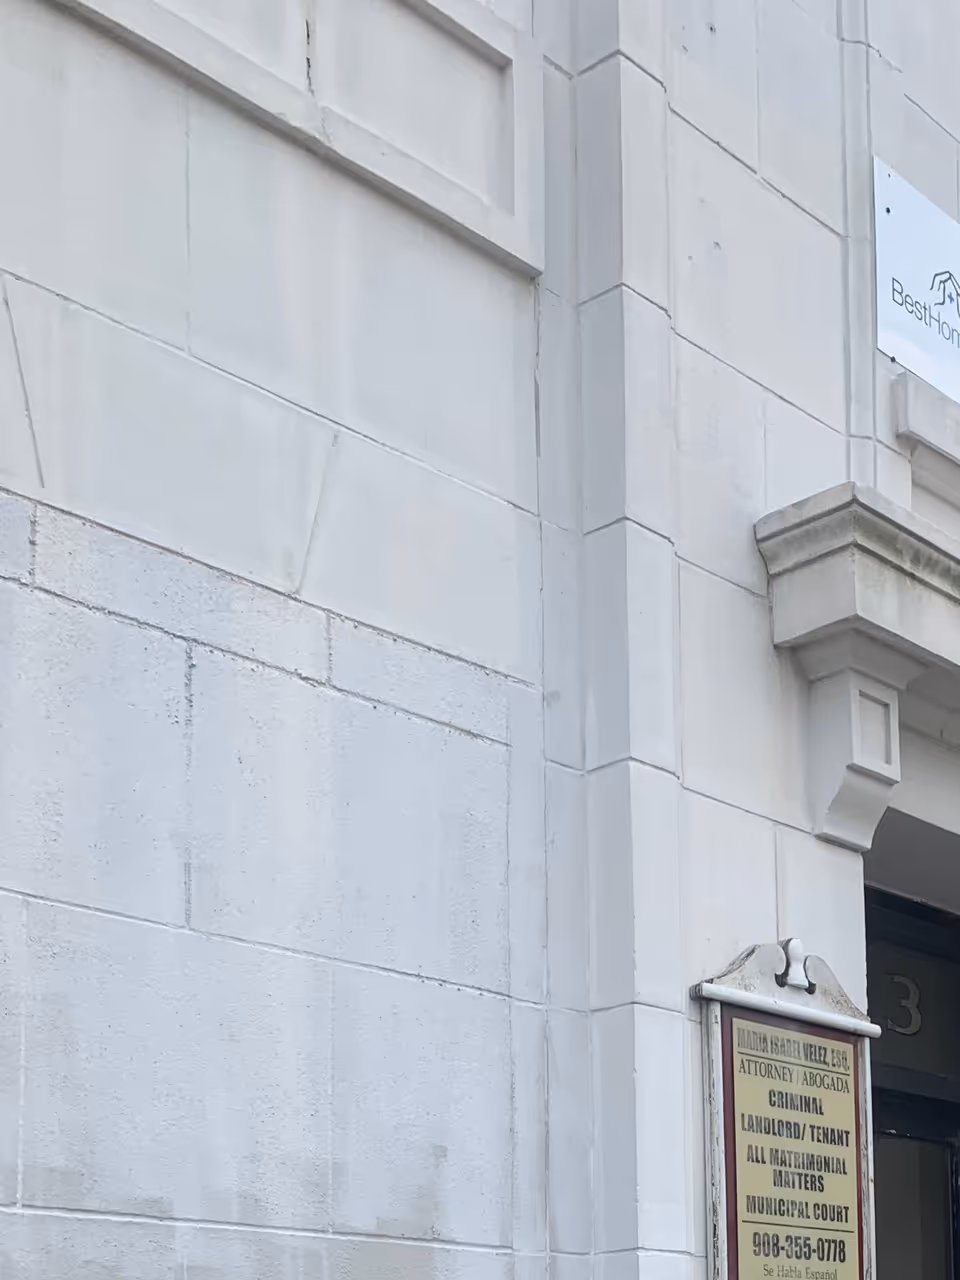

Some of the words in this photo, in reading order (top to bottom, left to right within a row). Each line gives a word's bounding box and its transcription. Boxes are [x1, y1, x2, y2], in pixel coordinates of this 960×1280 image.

[831, 1048, 850, 1072] ESQ.
[738, 1058, 794, 1083] ATTORNEY
[802, 1070, 850, 1094] ABOGADA
[768, 1089, 824, 1116] CRIMINAL
[809, 1124, 850, 1147] TENANT
[747, 1144, 766, 1164] ALL
[769, 1147, 848, 1175] MATRIMONIAL
[773, 1168, 824, 1193] MATTERS
[746, 1195, 811, 1219] MUNICIPAL
[813, 1202, 849, 1223] COURT
[752, 1232, 846, 1263] 908-355-0778
[763, 1264, 774, 1277] Se
[777, 1265, 802, 1279] Habla
